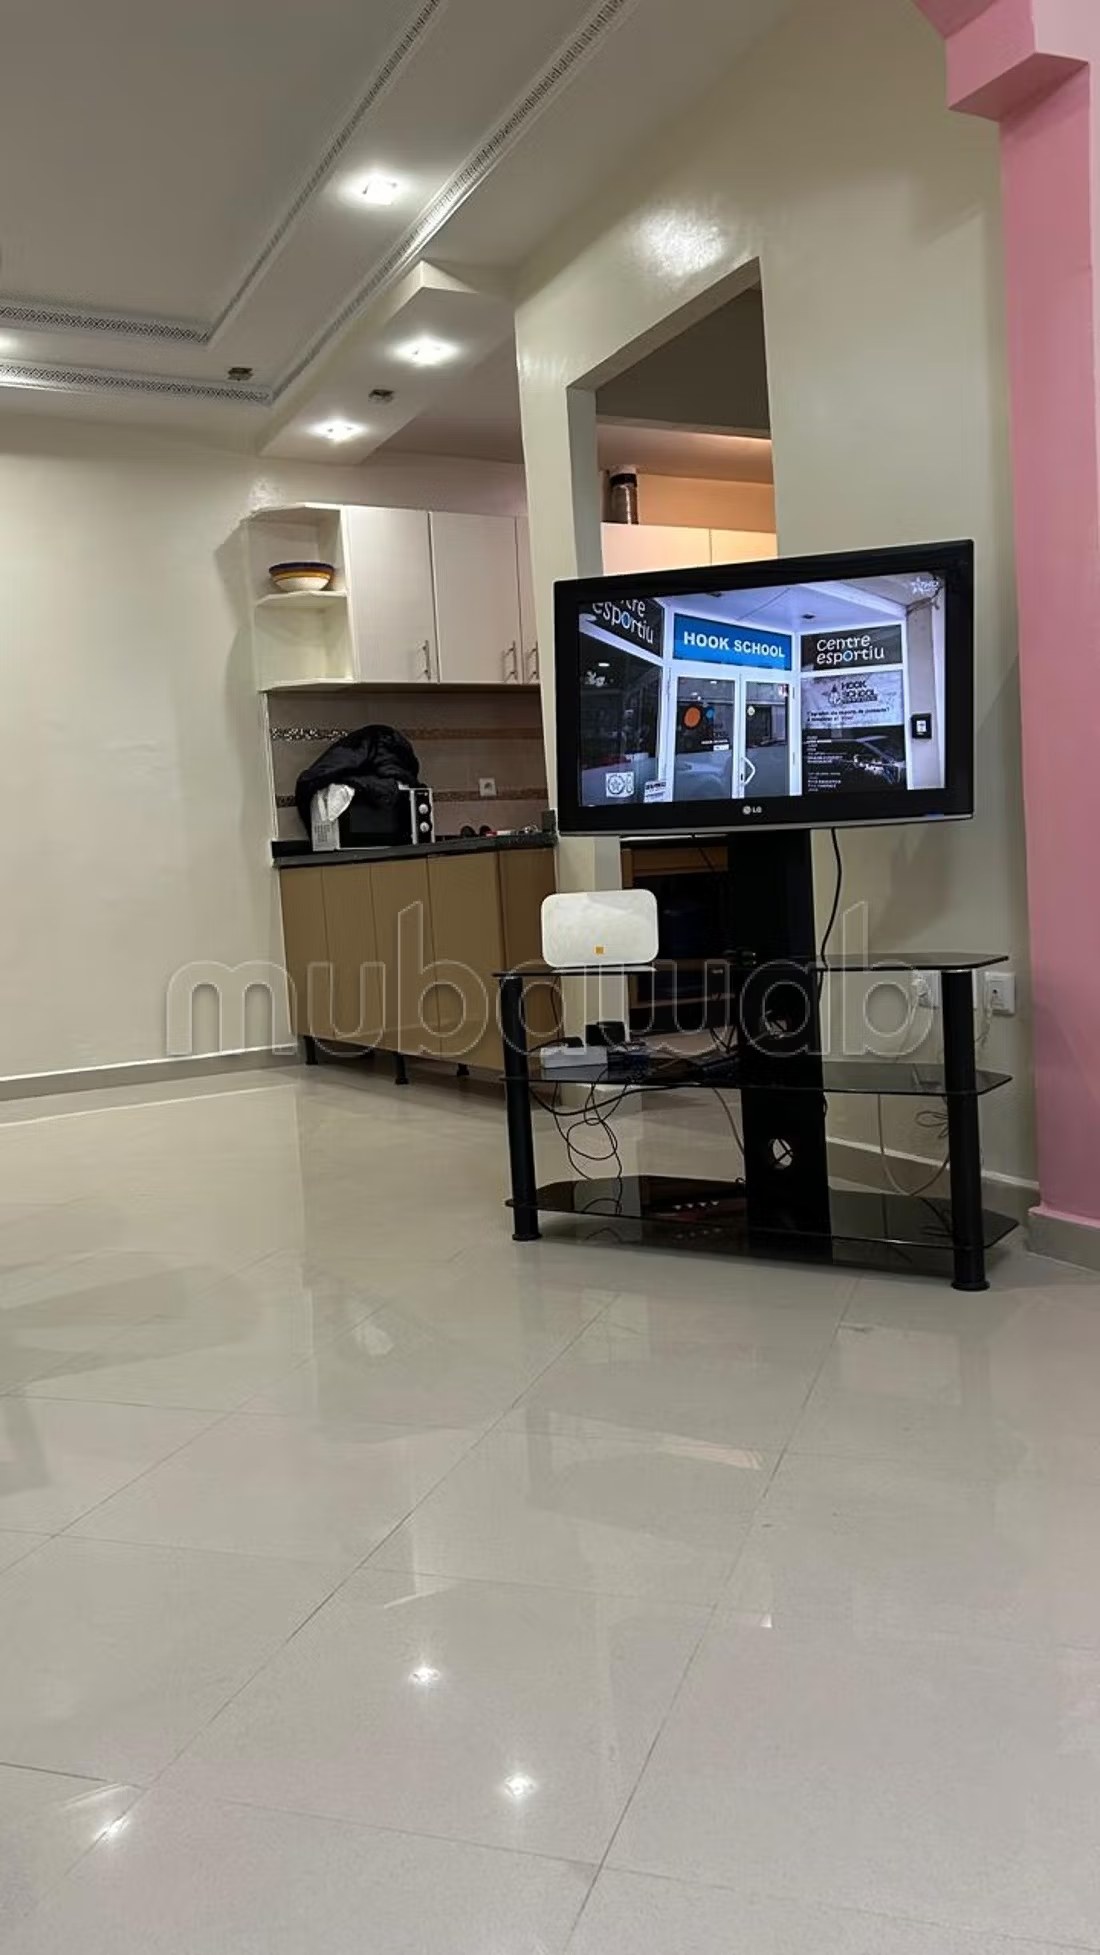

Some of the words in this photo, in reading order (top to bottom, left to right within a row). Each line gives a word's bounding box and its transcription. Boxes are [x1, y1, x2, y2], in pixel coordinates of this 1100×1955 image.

[592, 601, 653, 644] esportiu
[683, 631, 730, 650] HOOK
[733, 639, 785, 658] SCHOOL
[816, 644, 885, 665] esportiu
[841, 680, 867, 690] HOOK
